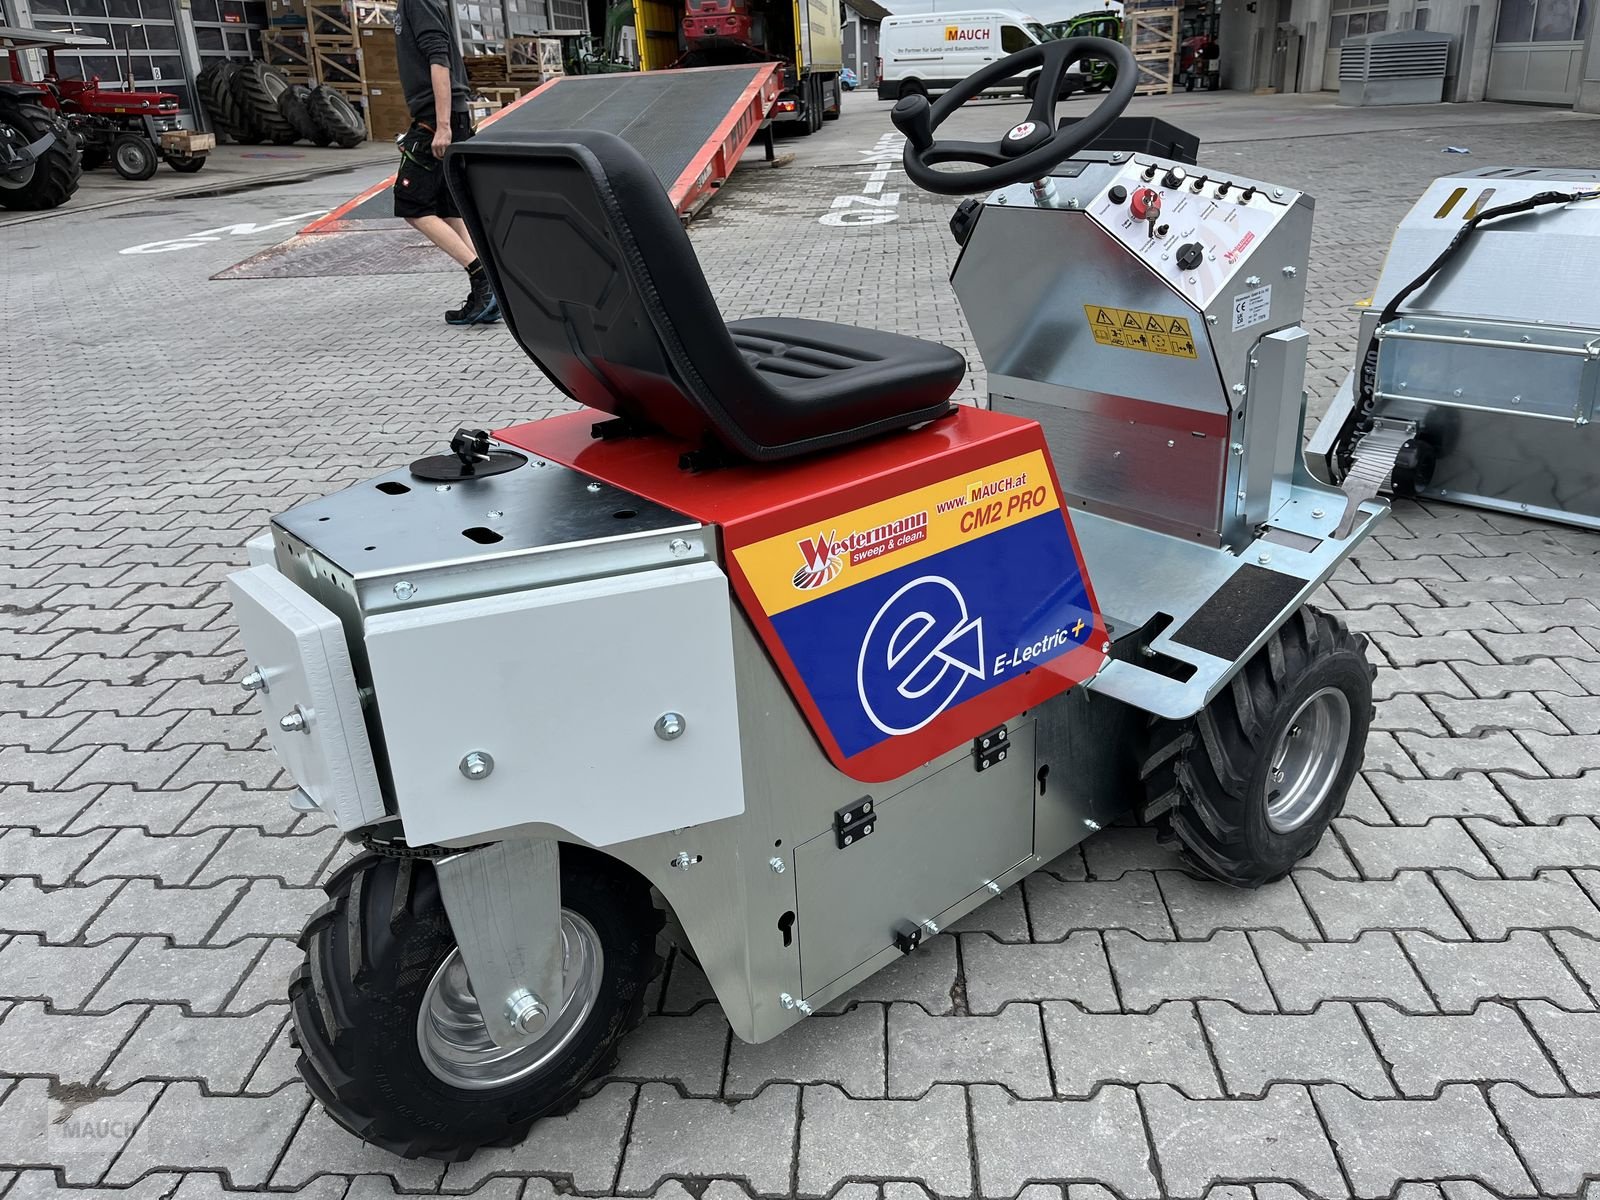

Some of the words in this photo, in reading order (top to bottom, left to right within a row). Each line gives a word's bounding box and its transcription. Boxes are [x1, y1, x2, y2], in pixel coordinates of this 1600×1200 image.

[948, 29, 990, 41] MAUCH
[960, 501, 1003, 533] CM2
[1007, 485, 1046, 517] PRO
[798, 511, 927, 571] Westermann
[853, 545, 885, 562] sweep
[888, 539, 895, 549] &
[897, 530, 925, 546] clean.
[993, 628, 1069, 676] E-Lectric
